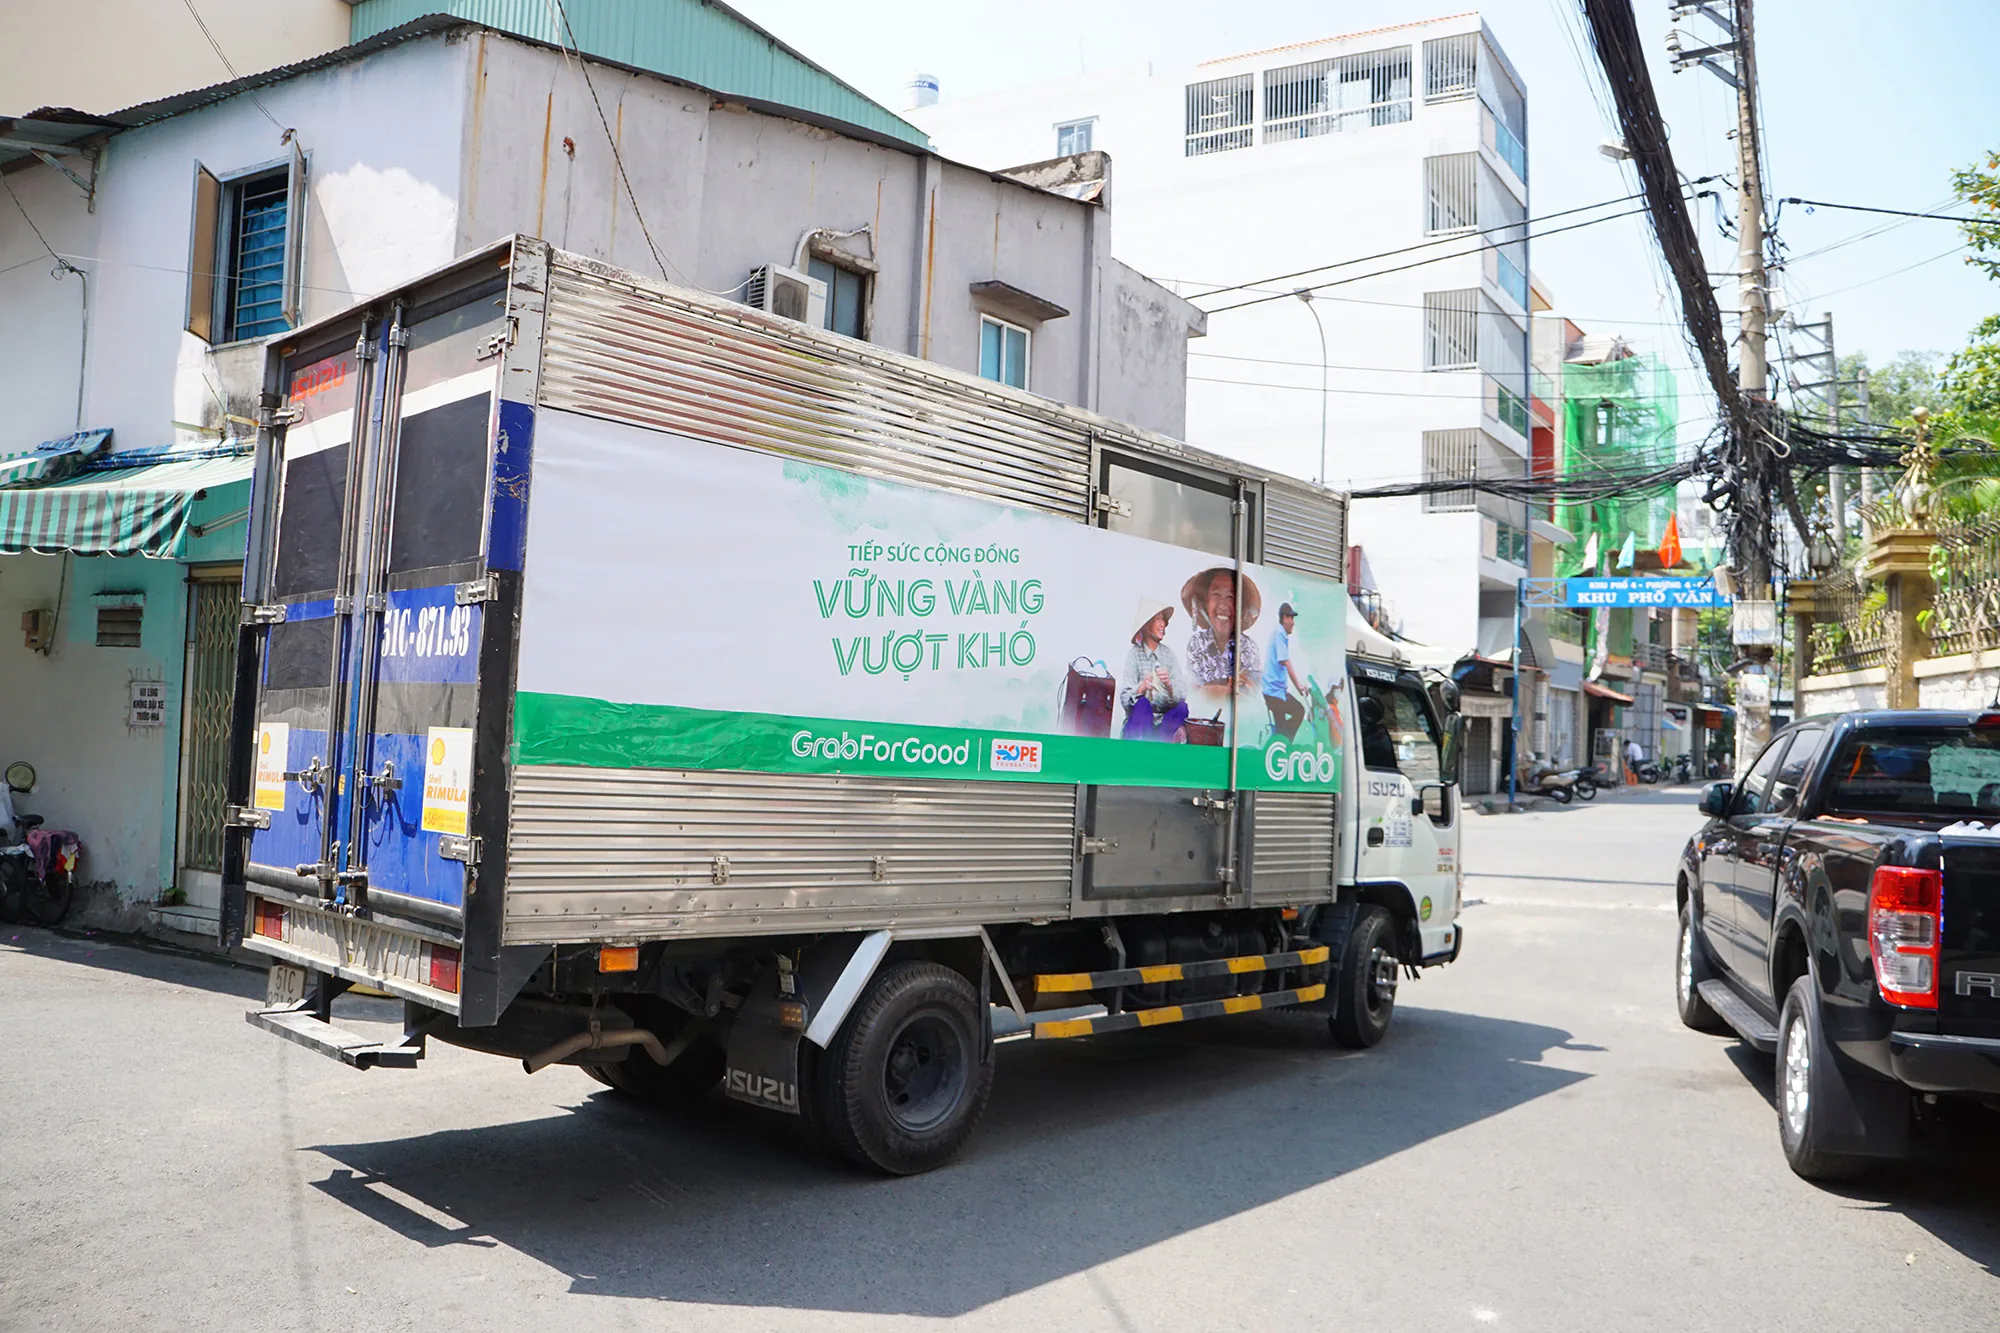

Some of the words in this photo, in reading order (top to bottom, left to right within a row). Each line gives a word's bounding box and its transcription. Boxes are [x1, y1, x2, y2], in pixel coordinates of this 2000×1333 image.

[290, 361, 347, 404] ISUZU
[847, 539, 883, 562] TIẾP
[887, 541, 920, 562] SỨC
[924, 542, 971, 566] CỘNG
[974, 542, 1020, 563] ĐỒNG
[812, 567, 937, 619] VỮNG
[944, 569, 1045, 616] VÀNG
[1577, 592, 1617, 604] KHU
[1627, 587, 1666, 603] PHỐ
[1673, 589, 1713, 603] VĂN
[381, 605, 471, 658] 51C-871.93
[832, 629, 949, 682] VƯỢT
[957, 620, 1037, 669] KHÓ
[1365, 668, 1397, 683] ISUZU
[791, 730, 970, 766] GrabForGood
[995, 744, 1038, 762] HOPE
[1265, 741, 1335, 783] Grab
[427, 772, 443, 784] Shell
[1368, 780, 1405, 798] ISUZU
[426, 785, 467, 803] RIMULA
[276, 966, 296, 994] 51C
[726, 1066, 795, 1106] ISUZU
